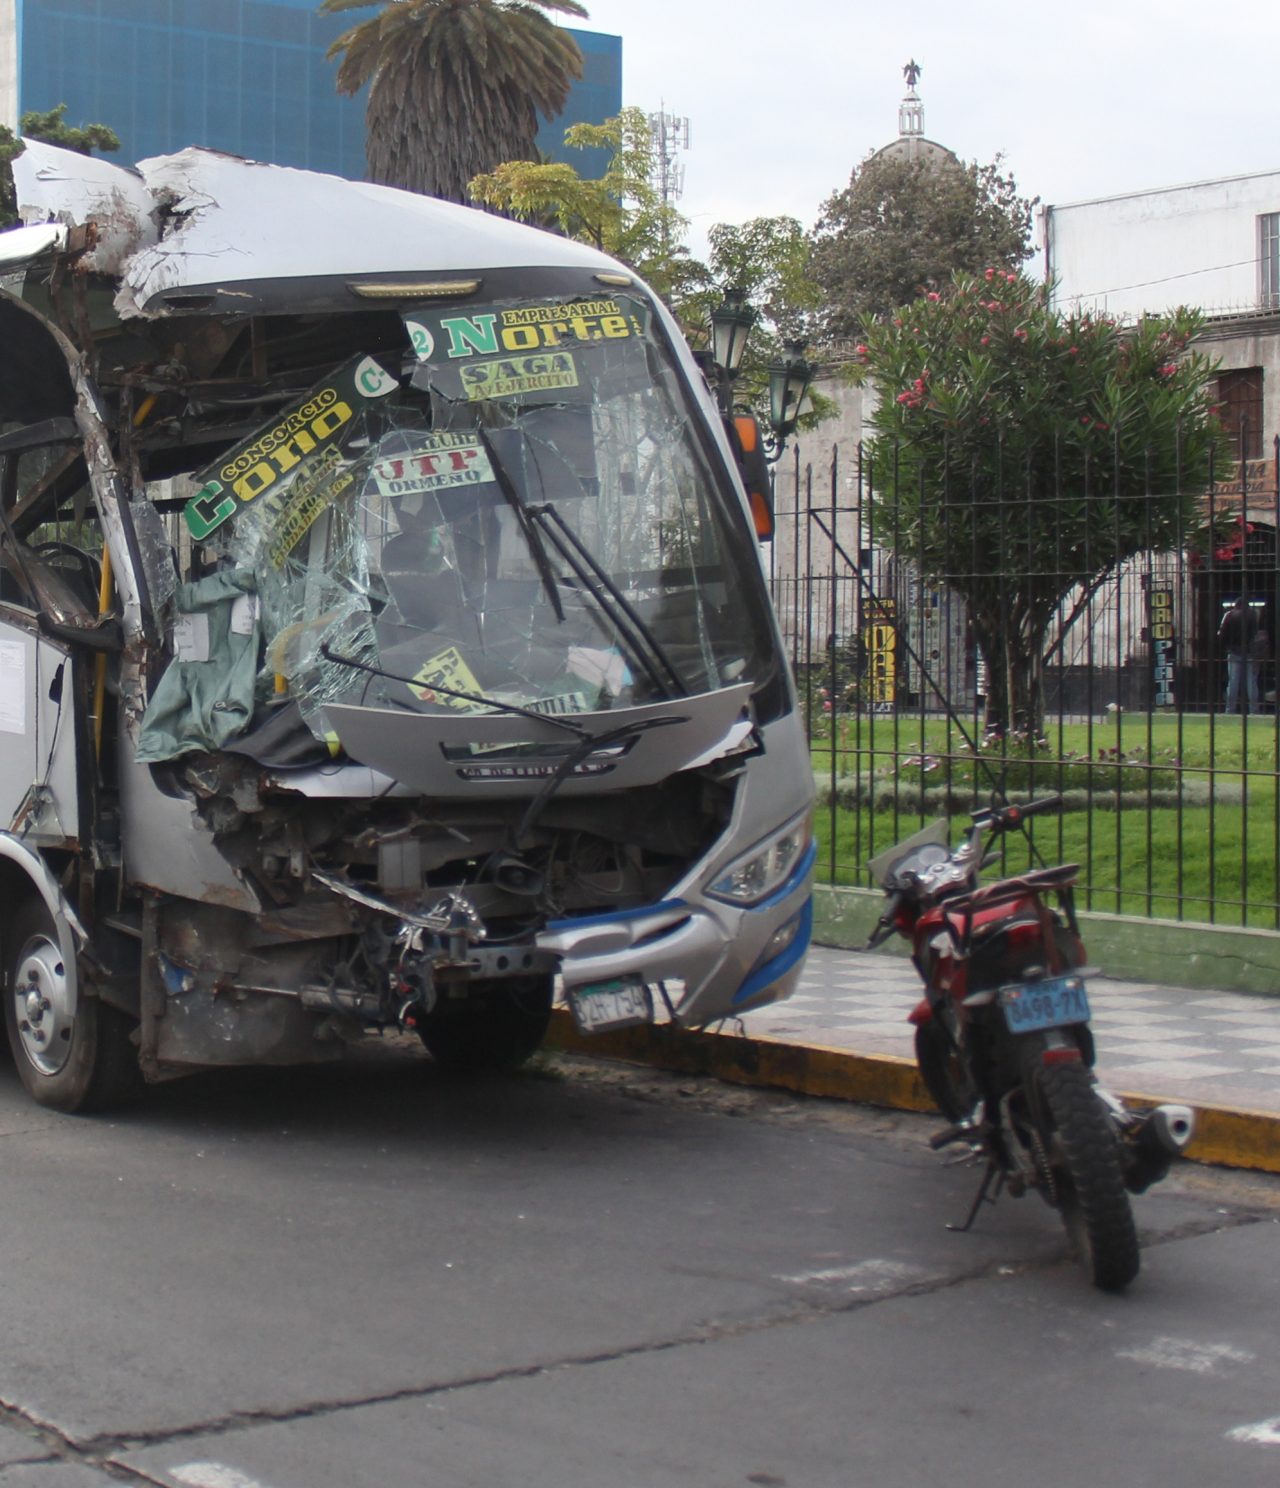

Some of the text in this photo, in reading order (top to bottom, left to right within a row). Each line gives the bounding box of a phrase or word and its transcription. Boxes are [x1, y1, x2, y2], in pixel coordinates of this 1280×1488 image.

[503, 301, 620, 324] EMPRESARIAL
[413, 330, 429, 353] 2
[440, 314, 630, 358] Norte
[464, 353, 571, 384] SAGA
[221, 388, 337, 481] CONSORCIO
[375, 450, 477, 479] UTP
